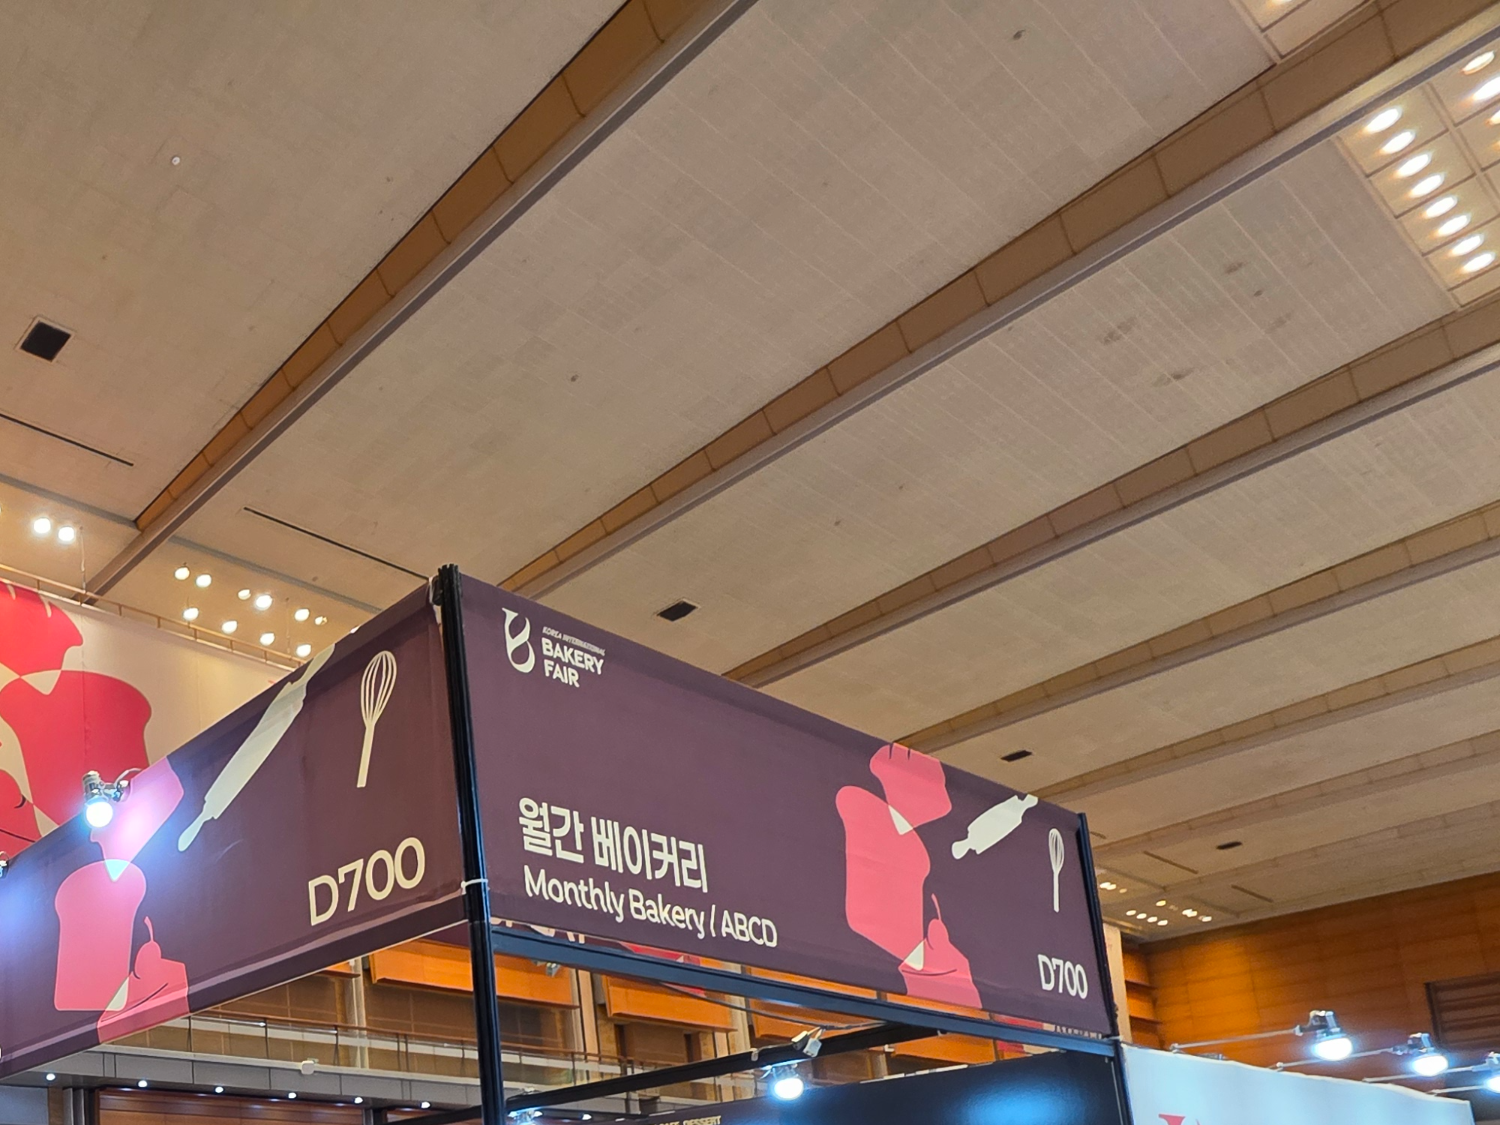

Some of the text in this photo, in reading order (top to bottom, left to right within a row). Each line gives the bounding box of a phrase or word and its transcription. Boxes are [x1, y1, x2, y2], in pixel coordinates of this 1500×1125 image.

[541, 637, 604, 675] BAKERY
[544, 659, 580, 688] FAIR
[518, 796, 708, 894] 월간 베이커리
[307, 836, 426, 927] D700
[523, 864, 625, 923] Monthly
[629, 889, 705, 940] Bakery
[721, 908, 778, 949] ABCD
[1037, 954, 1088, 1000] D700
